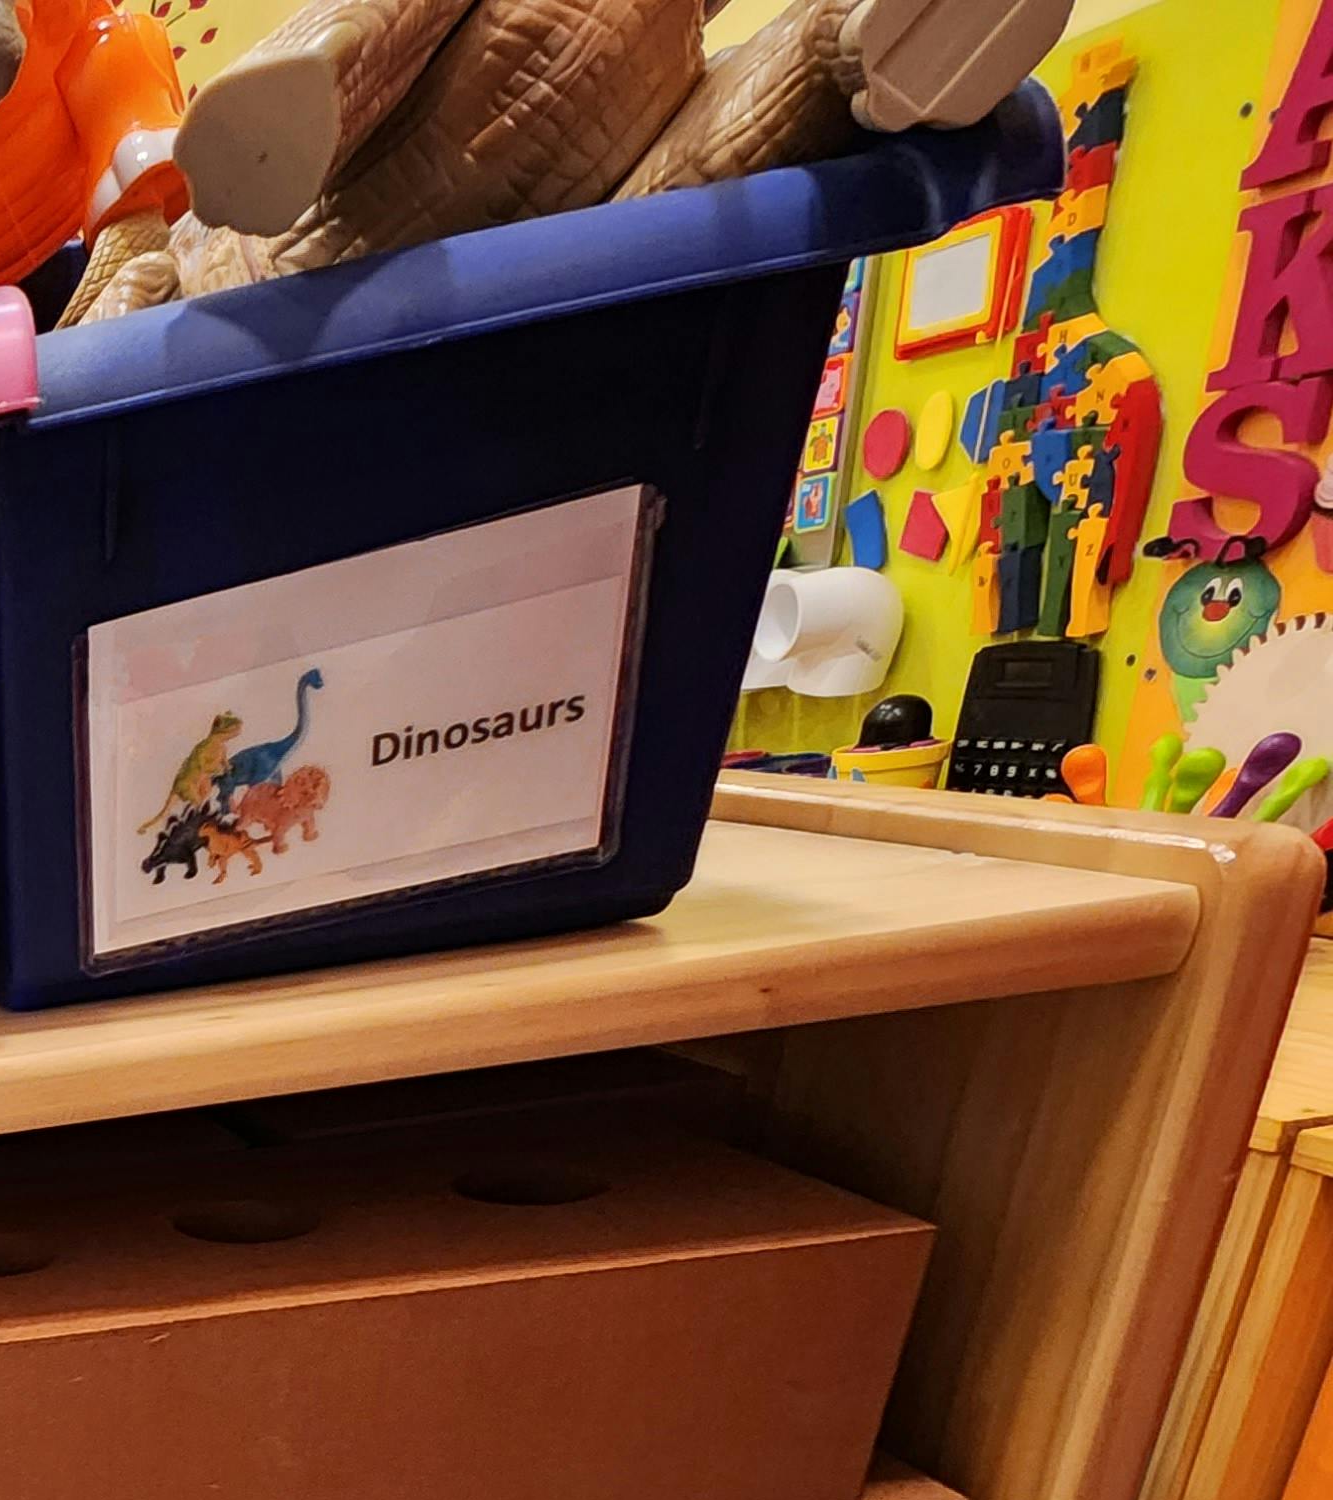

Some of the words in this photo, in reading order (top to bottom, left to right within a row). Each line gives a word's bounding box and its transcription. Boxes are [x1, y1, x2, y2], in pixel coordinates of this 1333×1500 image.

[371, 695, 585, 766] Dinosaurs
[974, 764, 983, 775] 7
[989, 765, 999, 776] 8
[1006, 766, 1017, 777] 9
